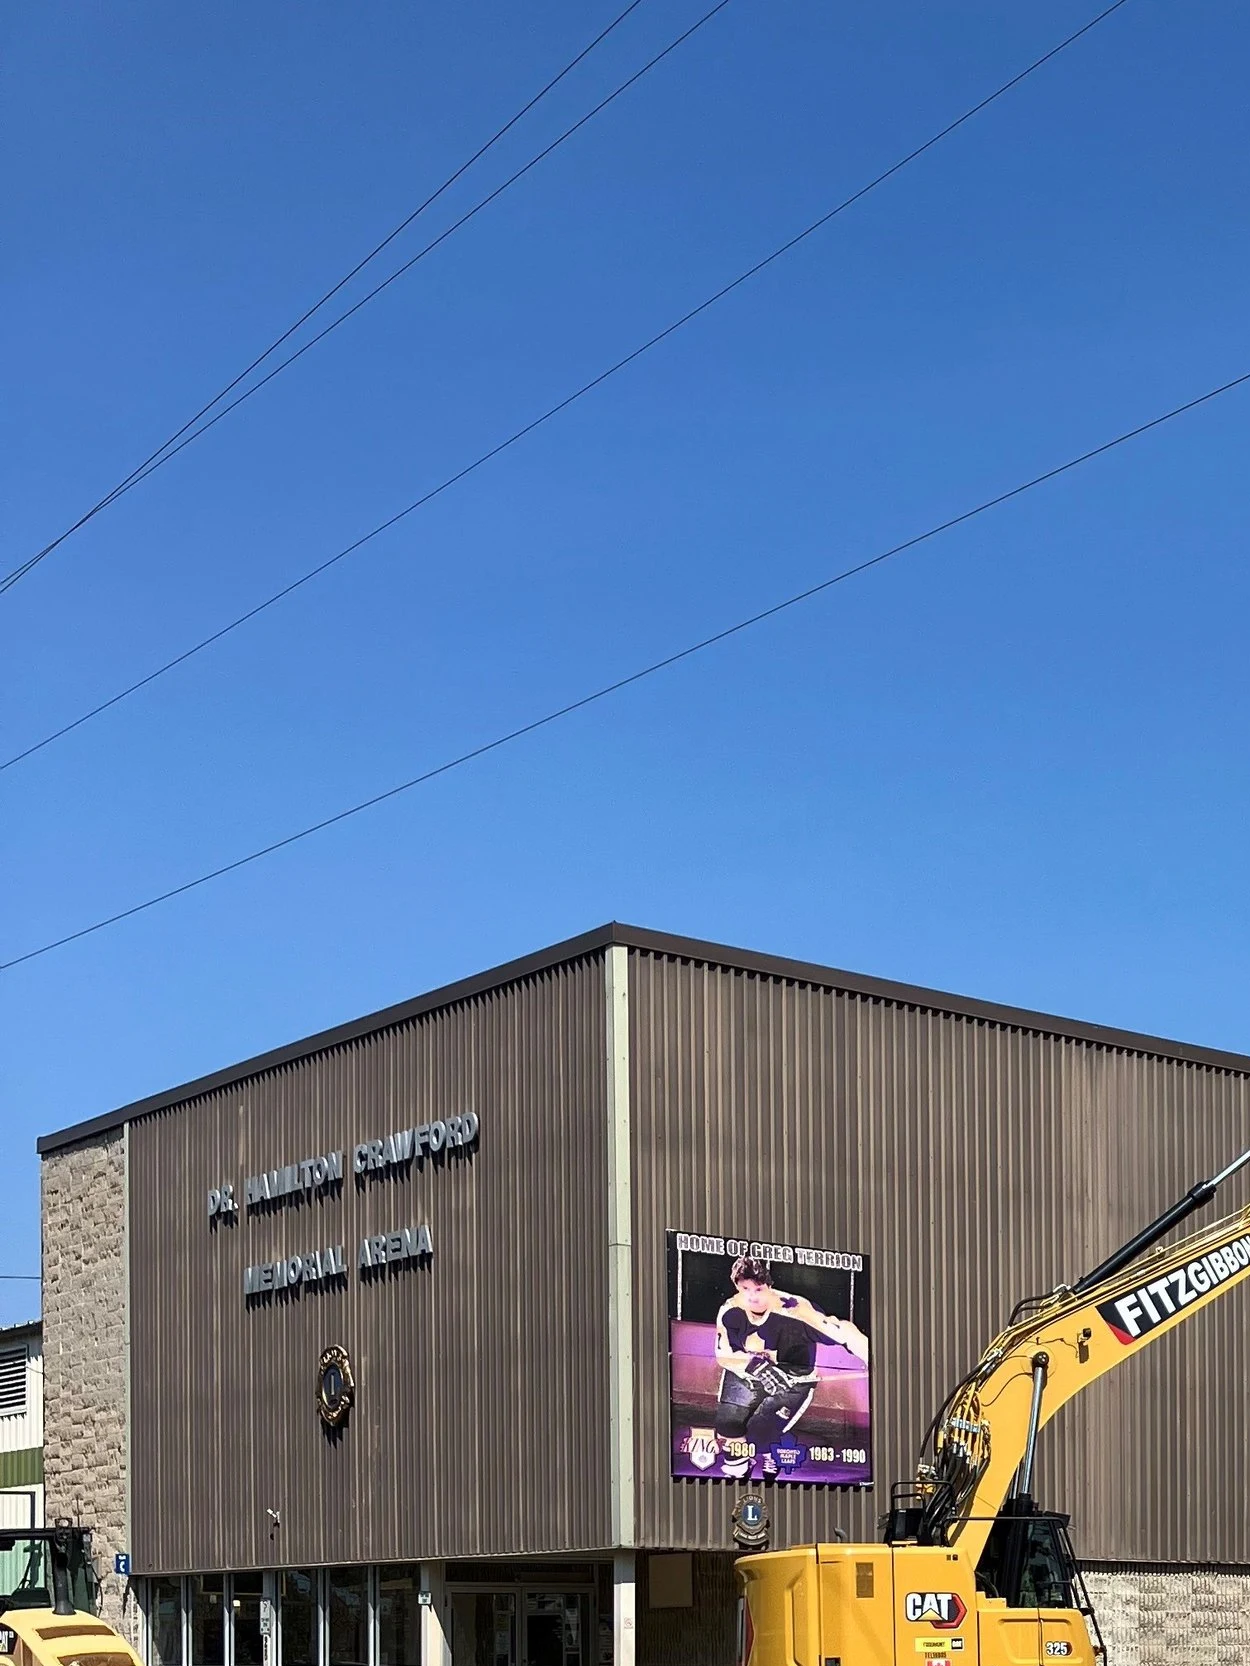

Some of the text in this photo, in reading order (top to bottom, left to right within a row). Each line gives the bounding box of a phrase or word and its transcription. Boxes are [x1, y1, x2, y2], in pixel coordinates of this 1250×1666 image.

[207, 1111, 479, 1216] DR. HAMILTON CRAWFORD
[243, 1224, 434, 1294] MEMORIAL ARENA
[677, 1233, 863, 1272] HOME OF GREG TERRION
[729, 1441, 756, 1458] 1980
[746, 1504, 759, 1521] L
[905, 1592, 953, 1621] CAT
[1045, 1641, 1068, 1656] 325
